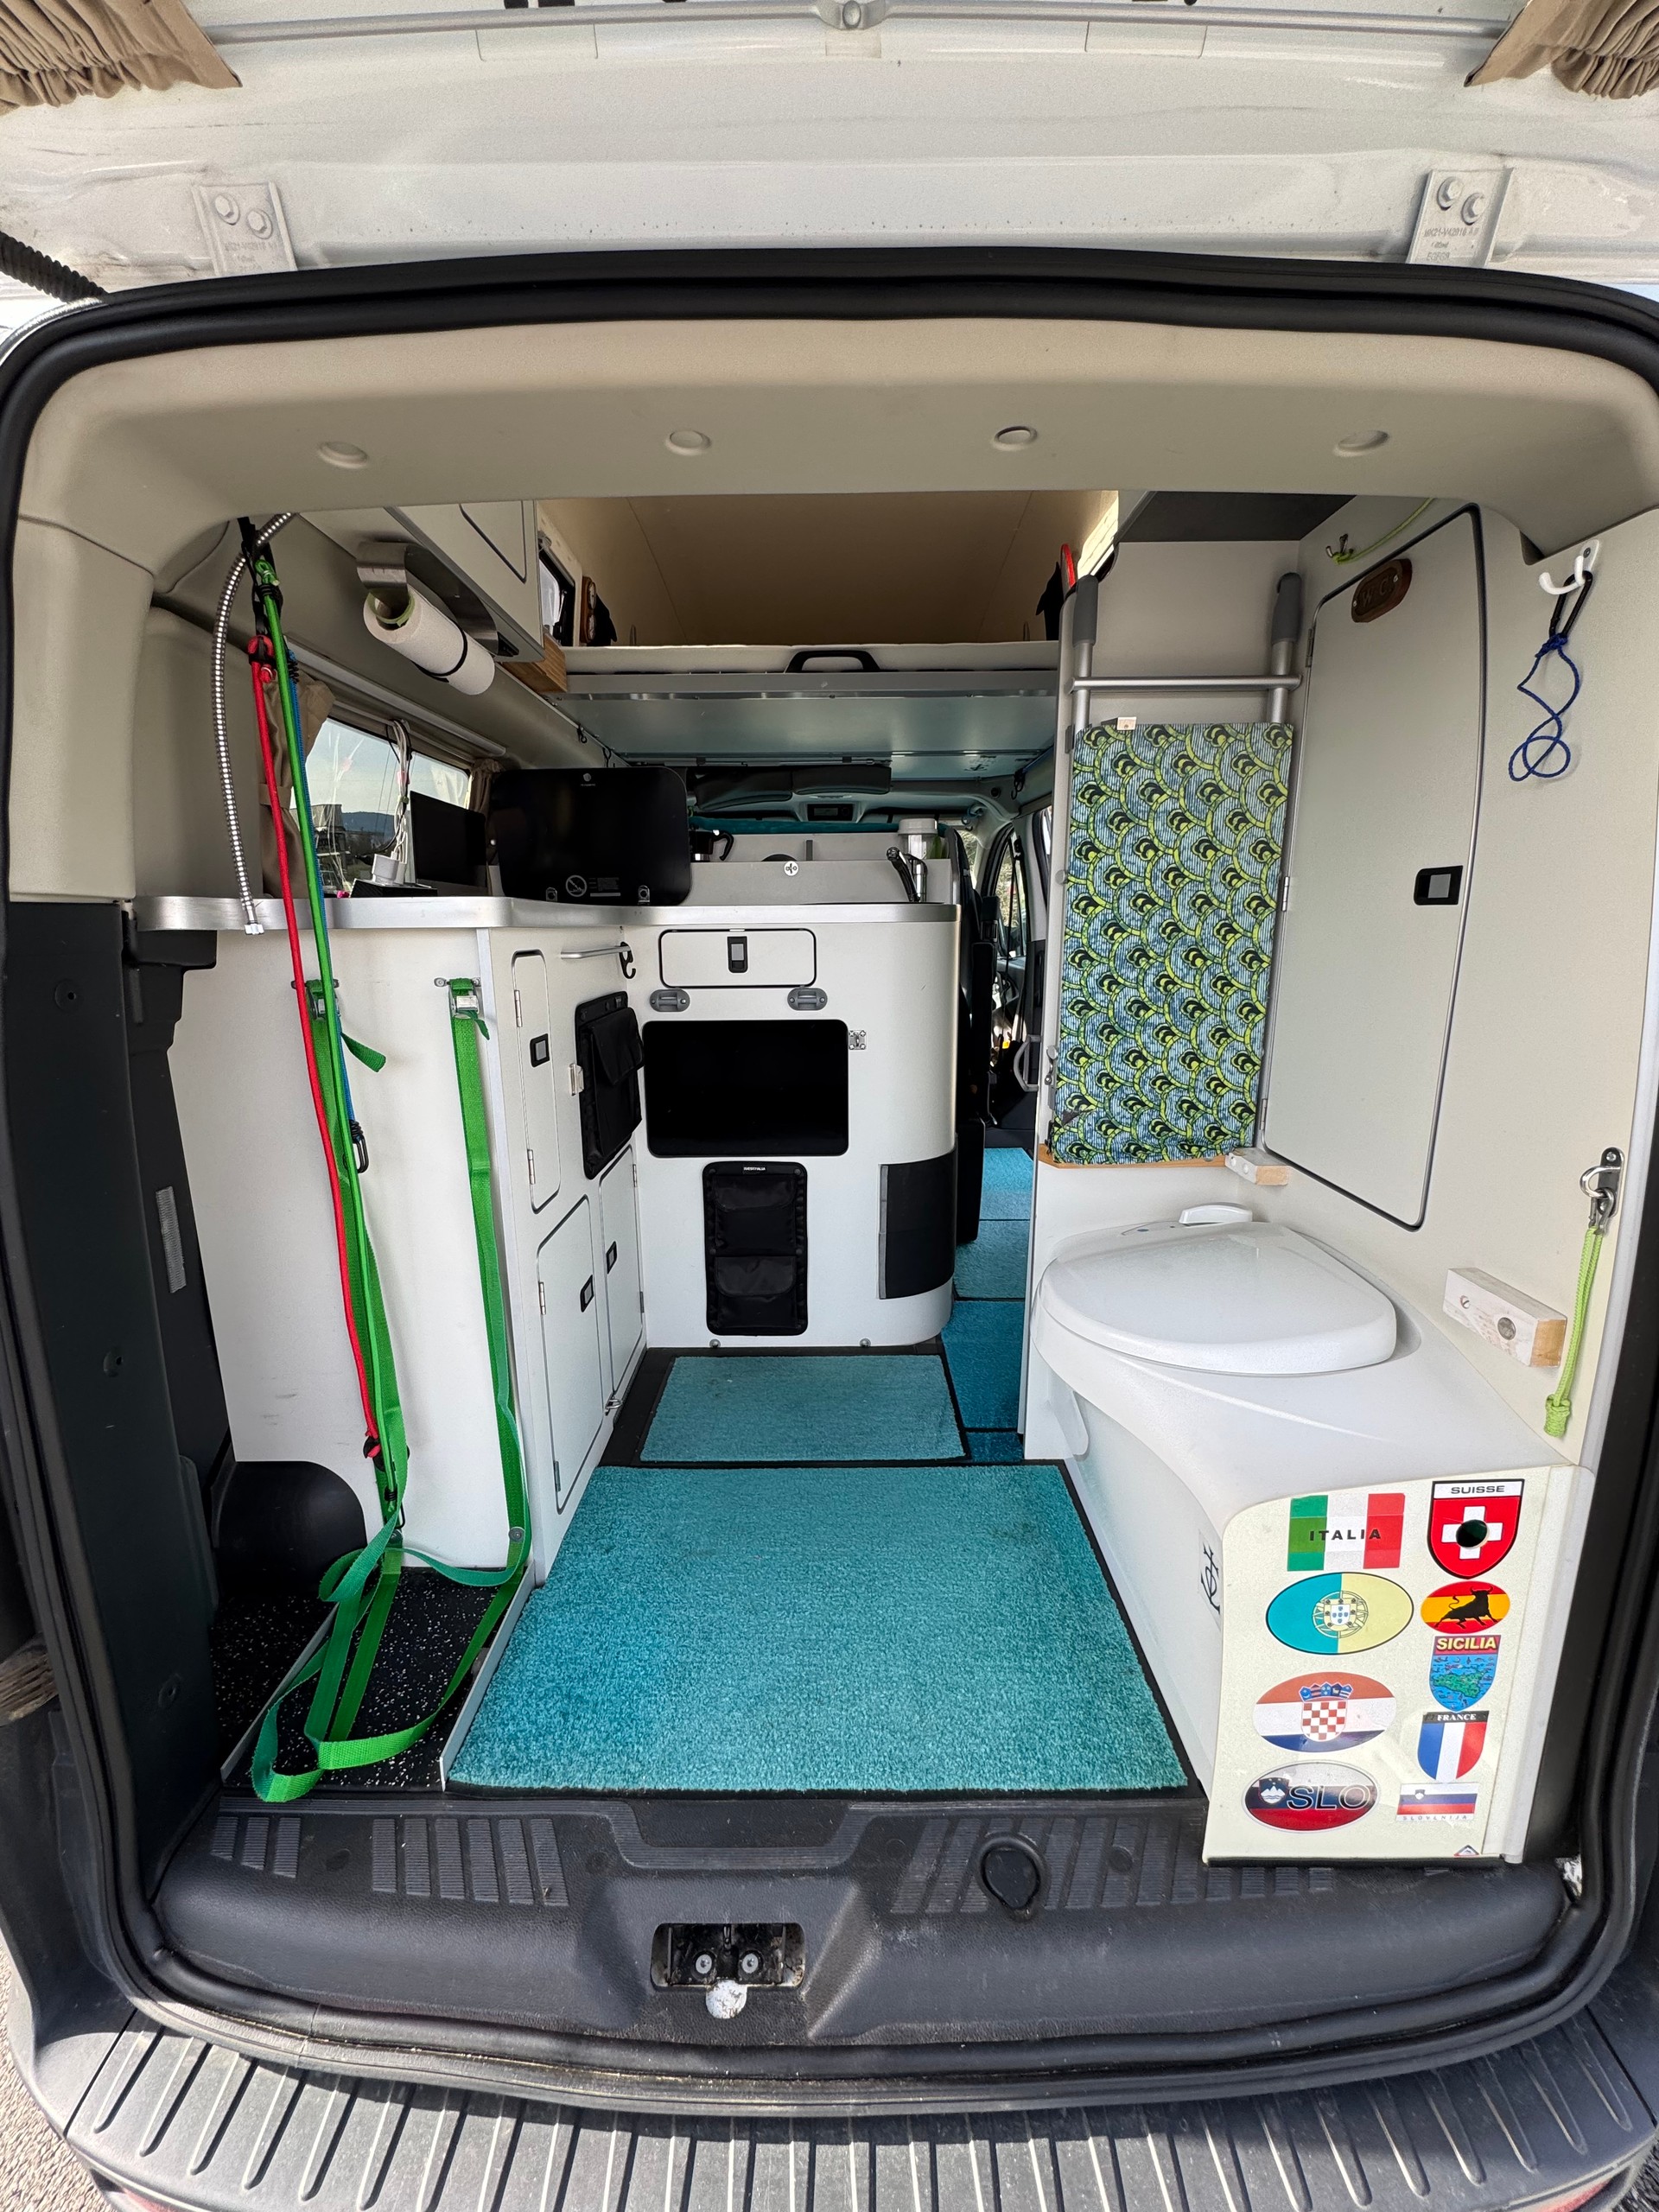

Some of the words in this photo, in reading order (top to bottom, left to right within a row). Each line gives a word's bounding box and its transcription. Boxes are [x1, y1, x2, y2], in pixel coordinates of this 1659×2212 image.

[1451, 1485, 1505, 1495] SUISSE
[1309, 1529, 1382, 1541] ITALIA
[1436, 1637, 1497, 1650] SICILIA
[1287, 1783, 1372, 1810] SLO
